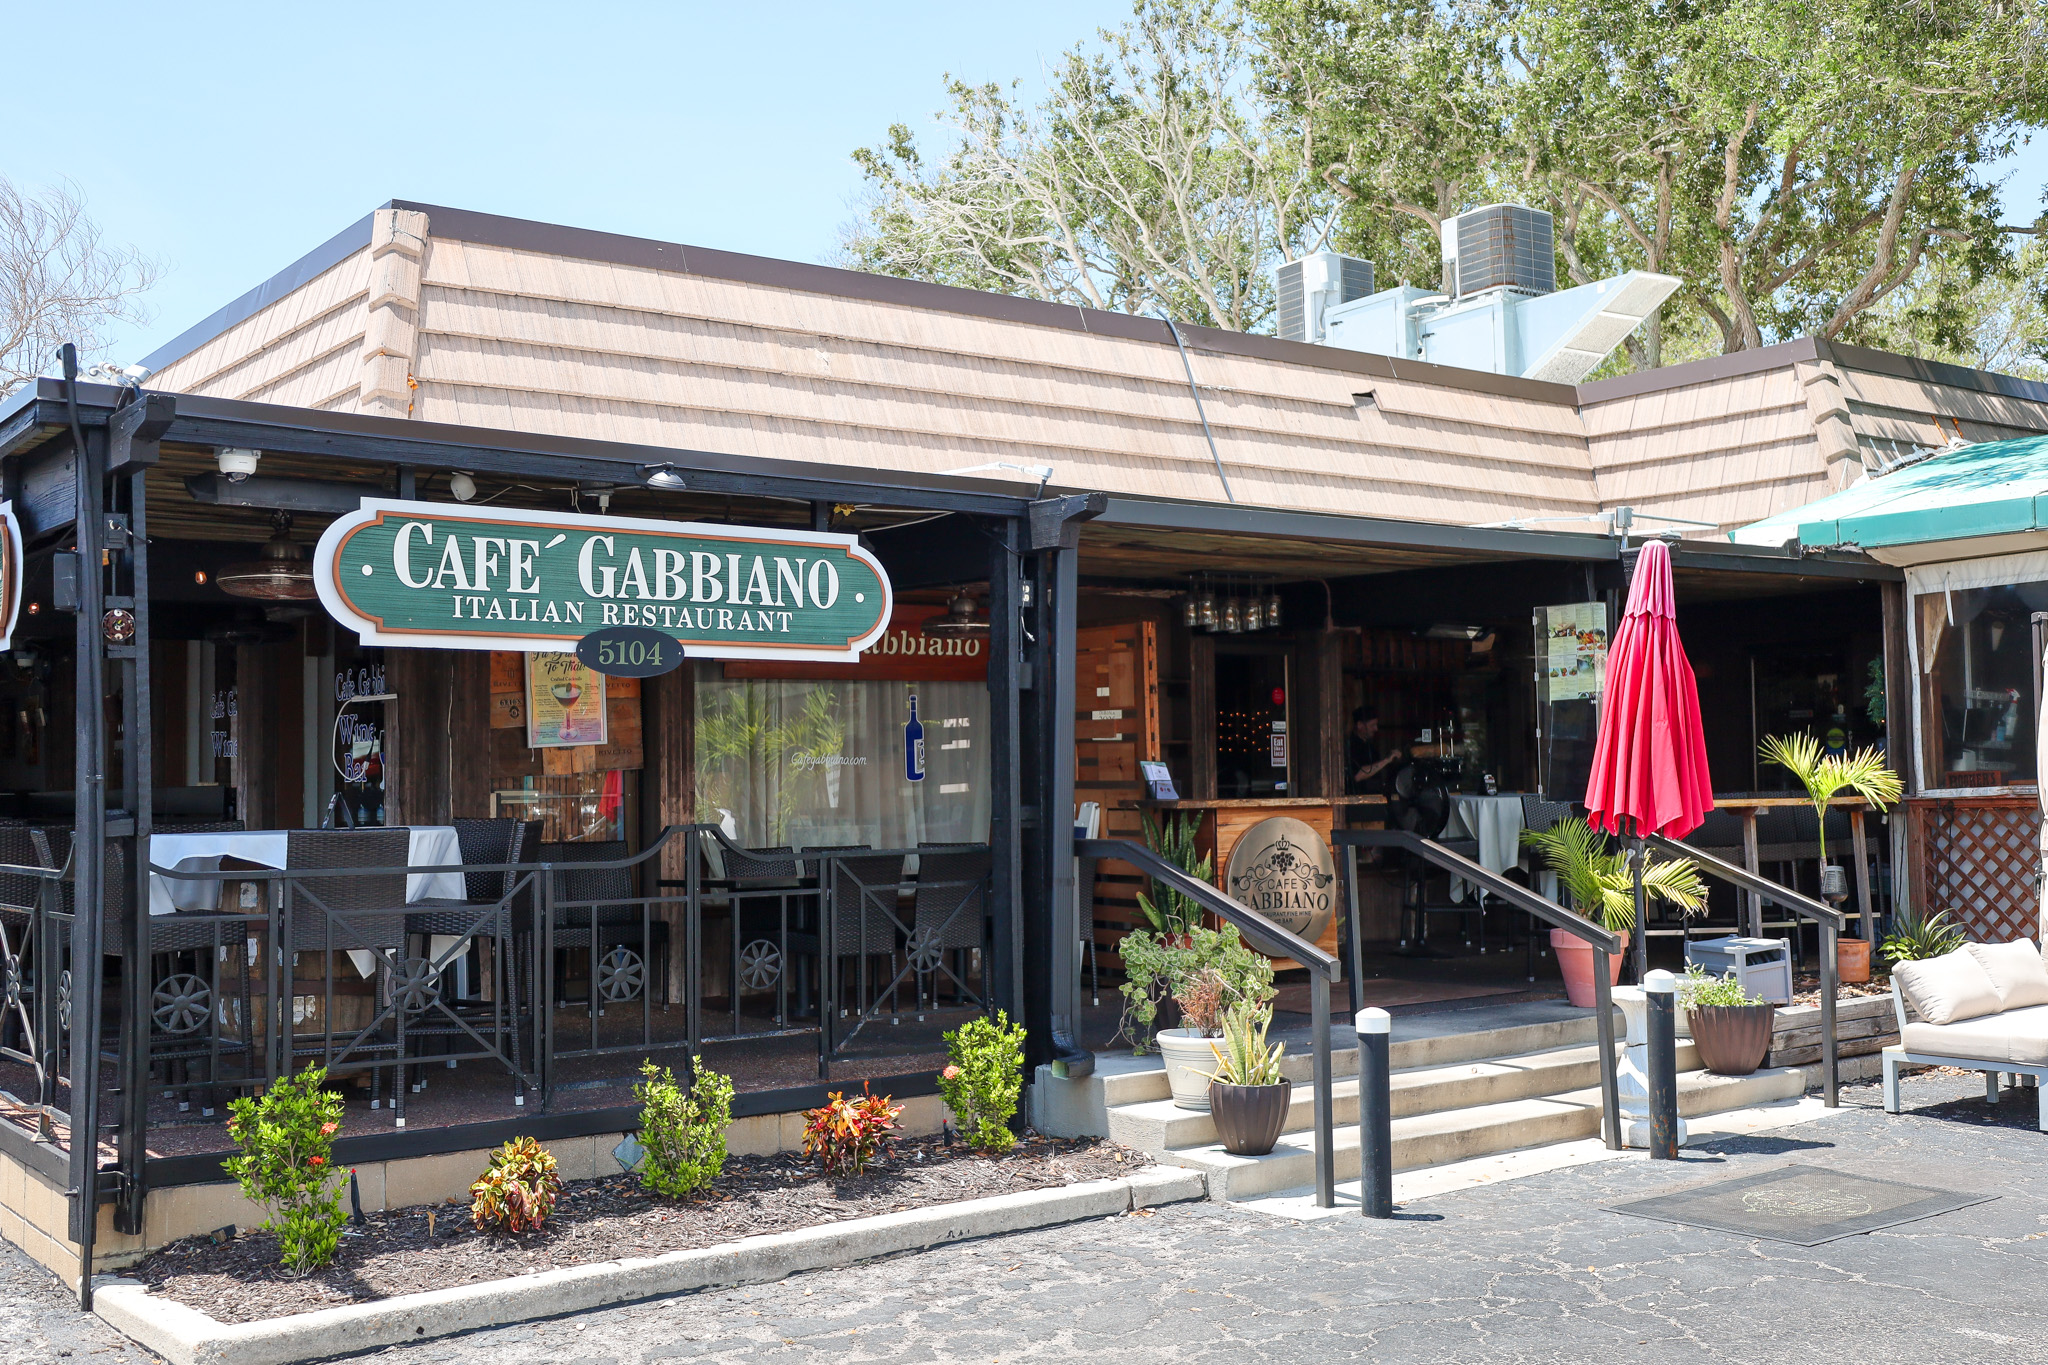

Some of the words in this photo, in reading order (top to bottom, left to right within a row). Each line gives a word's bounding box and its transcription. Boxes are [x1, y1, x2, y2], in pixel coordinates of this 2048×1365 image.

[578, 535, 840, 610] GABBIANO
[452, 595, 585, 624] ITALIAN
[601, 602, 794, 633] RESTAURANT
[598, 639, 664, 667] 5104
[1267, 878, 1298, 890] CAFE
